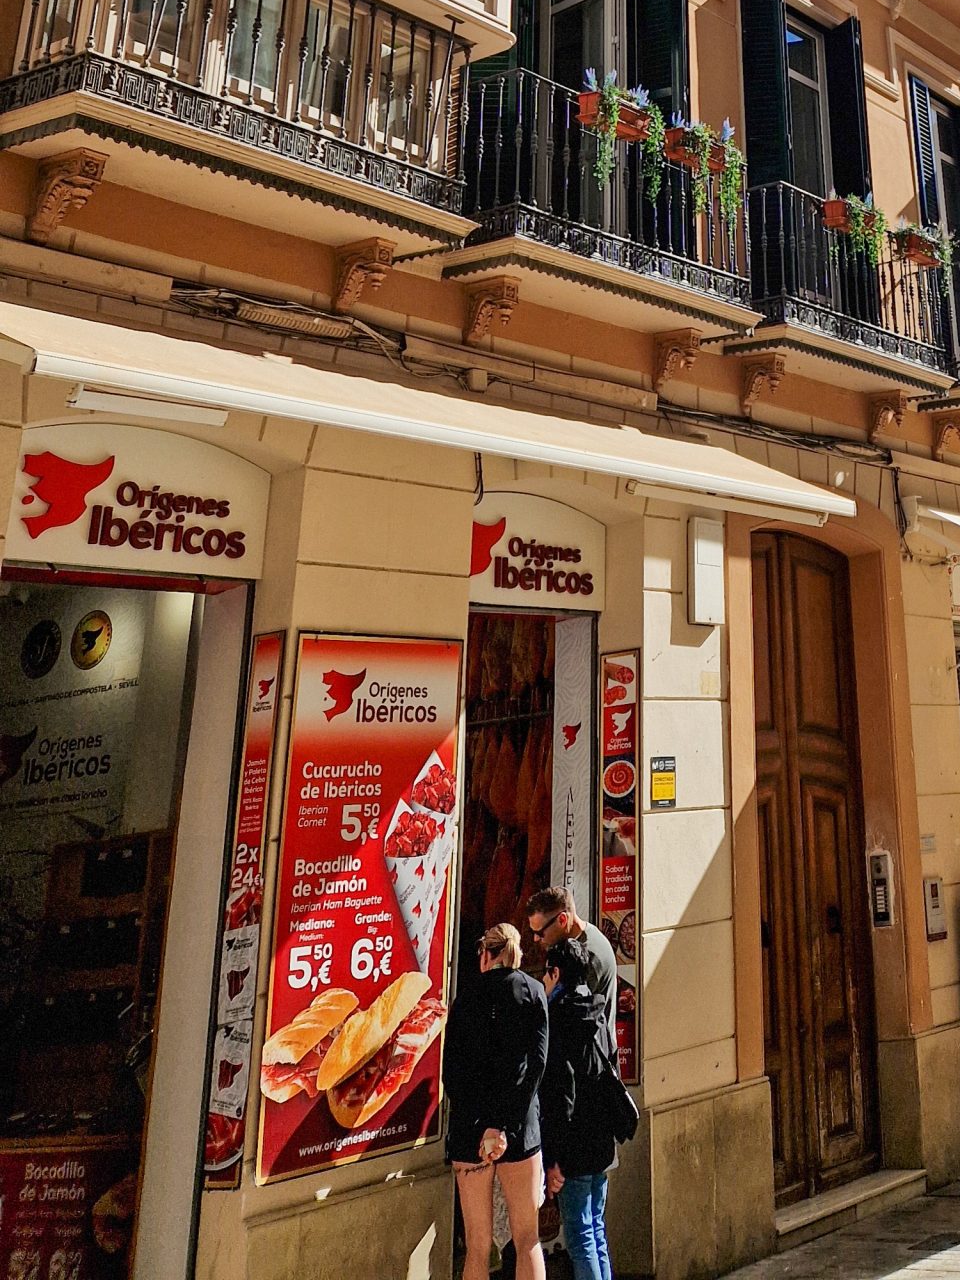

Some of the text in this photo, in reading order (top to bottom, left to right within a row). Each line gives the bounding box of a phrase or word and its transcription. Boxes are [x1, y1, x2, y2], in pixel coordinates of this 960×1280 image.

[116, 481, 230, 520] Orígenes
[87, 505, 246, 559] Ibéricos
[508, 536, 581, 566] Orígenes
[494, 556, 594, 595] Ibéricos
[72, 684, 112, 698] COMPOSTELA
[369, 681, 428, 704] Orígenes
[356, 698, 437, 723] Ibéricos
[39, 733, 102, 760] Orígenes
[23, 753, 111, 786] Ibéricos
[247, 759, 266, 767] Jamón
[302, 761, 382, 780] Cucurucho
[300, 780, 382, 800] de Ibéricos
[298, 805, 329, 816] Iberian
[236, 843, 259, 864] 2x
[294, 855, 362, 877] Bocadillo
[605, 865, 630, 874] Sabor y
[292, 875, 368, 898] de Jamón
[605, 873, 633, 883] tradición
[614, 883, 630, 892] cada
[290, 895, 383, 914] Iberian Ham Baguette
[605, 894, 626, 904] loncha
[289, 918, 335, 933] Mediano:
[354, 911, 392, 926] Grande:
[298, 1123, 408, 1157] www.origenesibericos.es
[25, 1161, 85, 1180] Bocadillo
[18, 1183, 86, 1201] de Jamón
